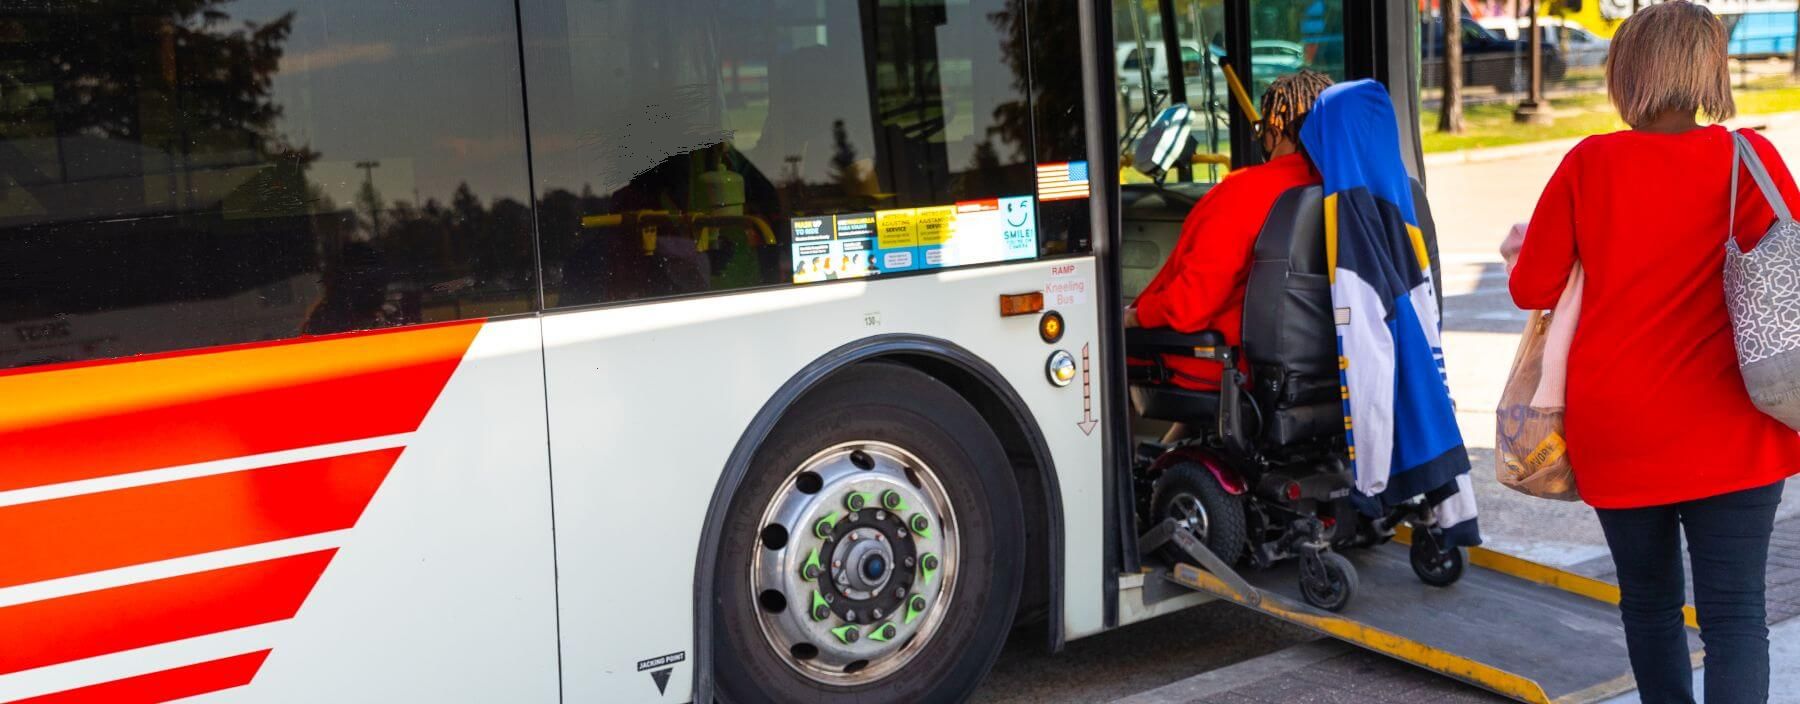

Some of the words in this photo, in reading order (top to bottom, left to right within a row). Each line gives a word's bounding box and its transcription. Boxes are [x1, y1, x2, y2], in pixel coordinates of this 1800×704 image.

[795, 228, 805, 236] TO
[1004, 229, 1033, 240] SMILE!
[1052, 265, 1075, 275] RAMP
[1045, 281, 1085, 294] Kneeling
[1057, 294, 1074, 305] Bus
[639, 656, 666, 670] JACKING
[666, 652, 684, 663] POINT
